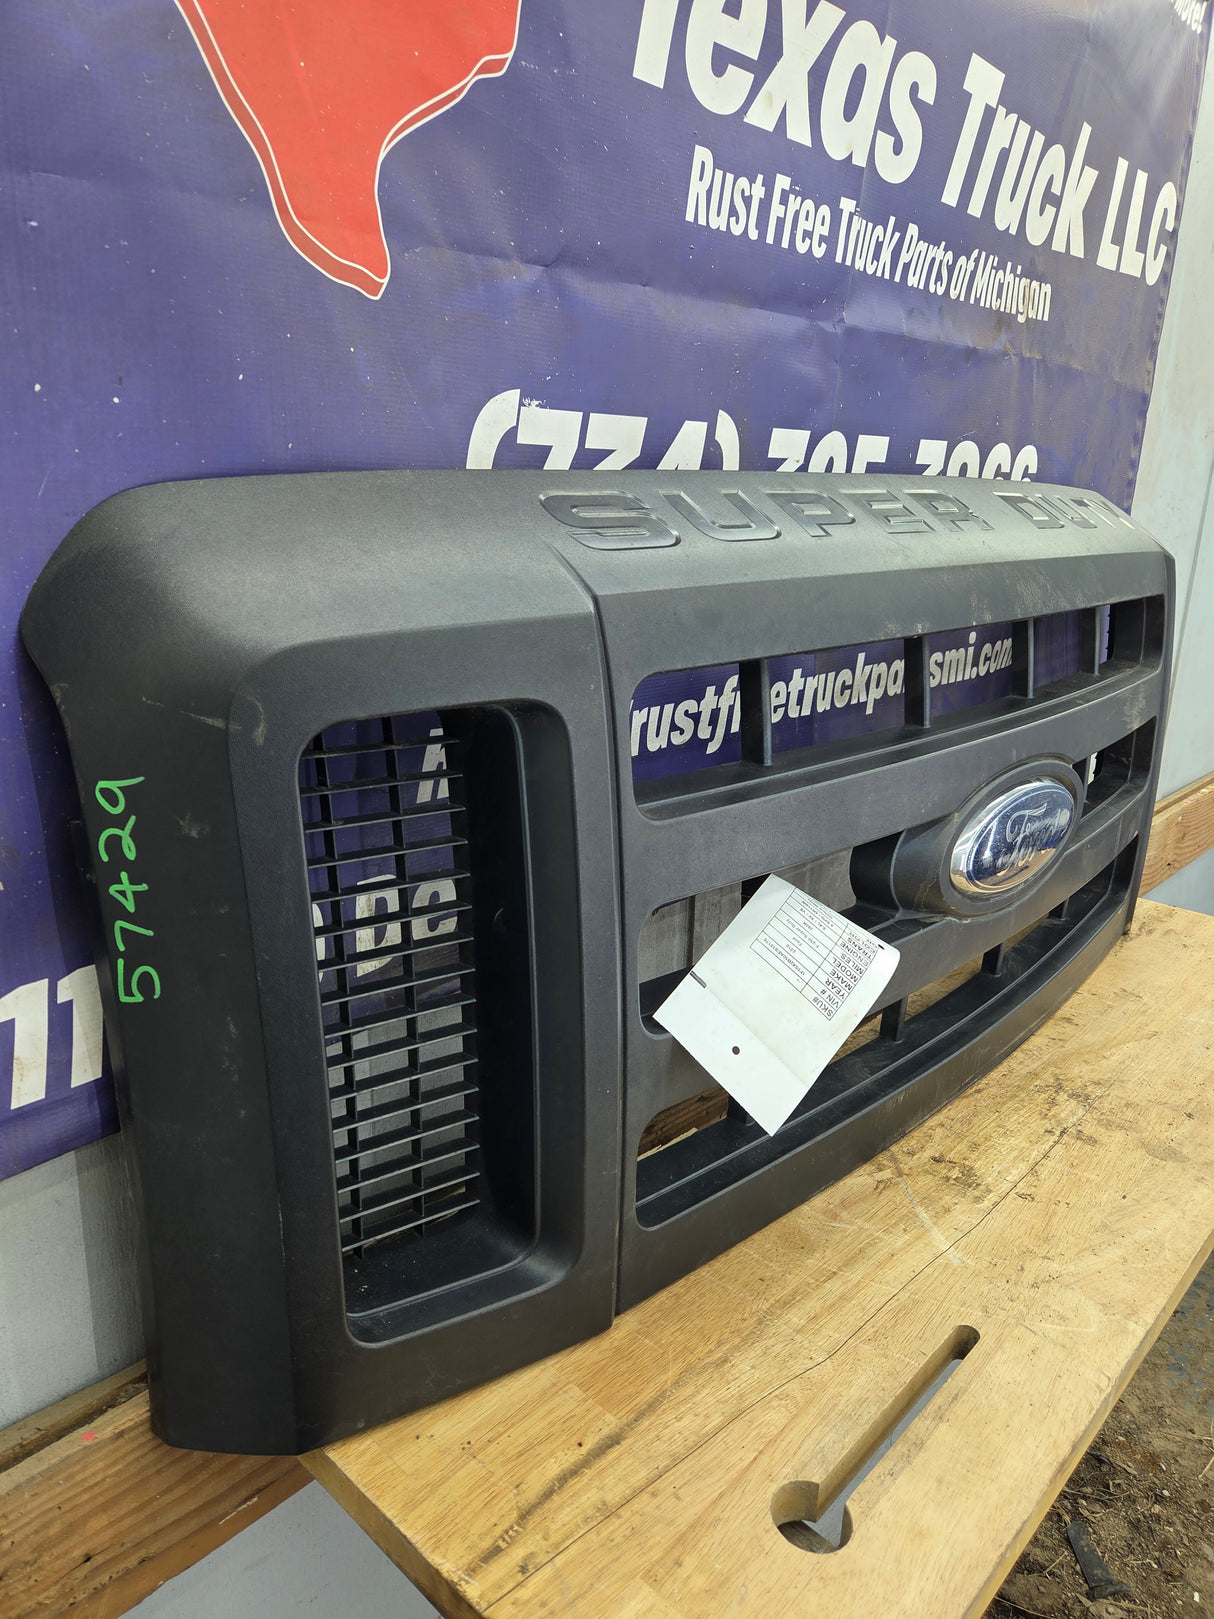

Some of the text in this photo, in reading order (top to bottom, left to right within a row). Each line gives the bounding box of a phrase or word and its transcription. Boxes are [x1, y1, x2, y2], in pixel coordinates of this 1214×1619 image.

[941, 52, 1099, 258] Truck
[1095, 157, 1177, 286] LLC
[685, 145, 1052, 322] Rust Free Truck Parts of Michigan
[539, 488, 994, 550] SUPER
[95, 776, 161, 1003] 57429
[838, 939, 869, 967] ENGINE
[845, 936, 873, 960] TRANS
[829, 955, 859, 982] MODEL
[839, 952, 864, 974] MILES
[823, 977, 847, 999] YEAR
[828, 967, 853, 991] MAKE
[819, 987, 827, 996] #
[825, 992, 840, 1008] VIN
[811, 994, 834, 1018] SKU#
